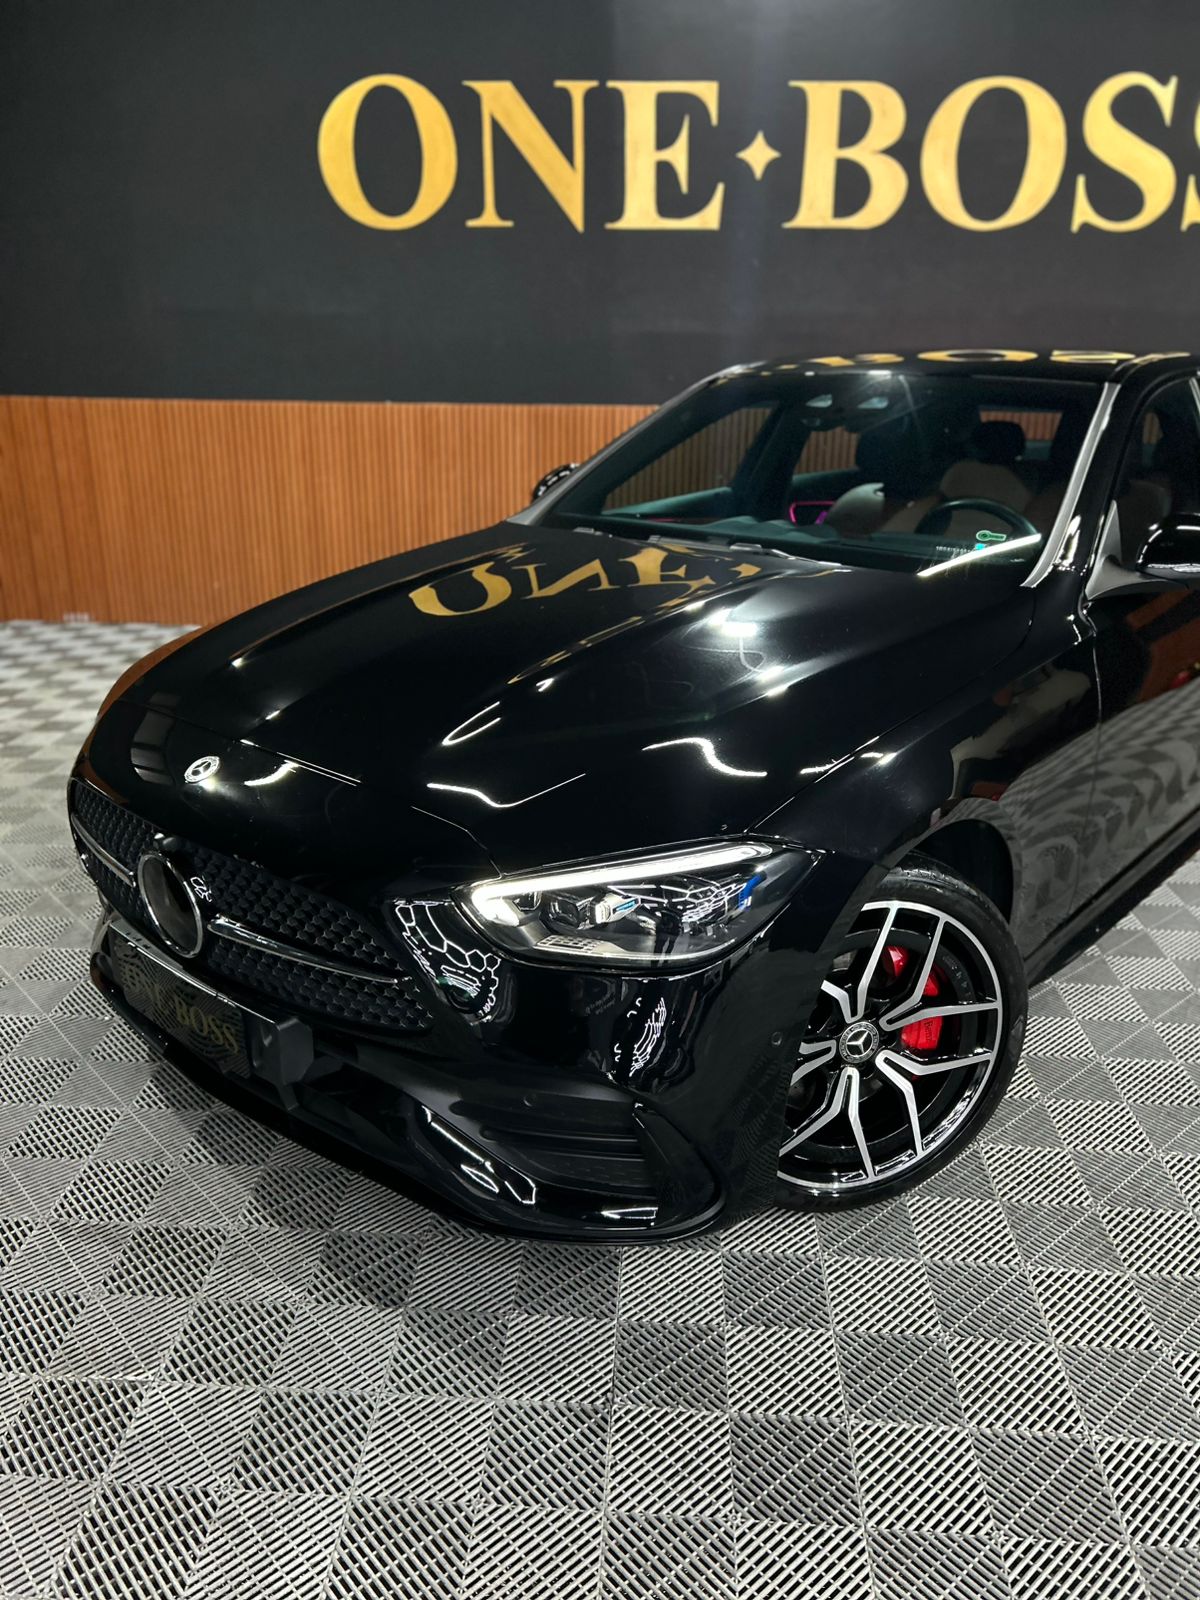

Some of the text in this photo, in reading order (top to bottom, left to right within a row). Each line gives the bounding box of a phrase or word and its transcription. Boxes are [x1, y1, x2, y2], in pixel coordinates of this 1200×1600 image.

[318, 71, 1200, 233] ONE BOS
[175, 998, 239, 1055] BOSS
